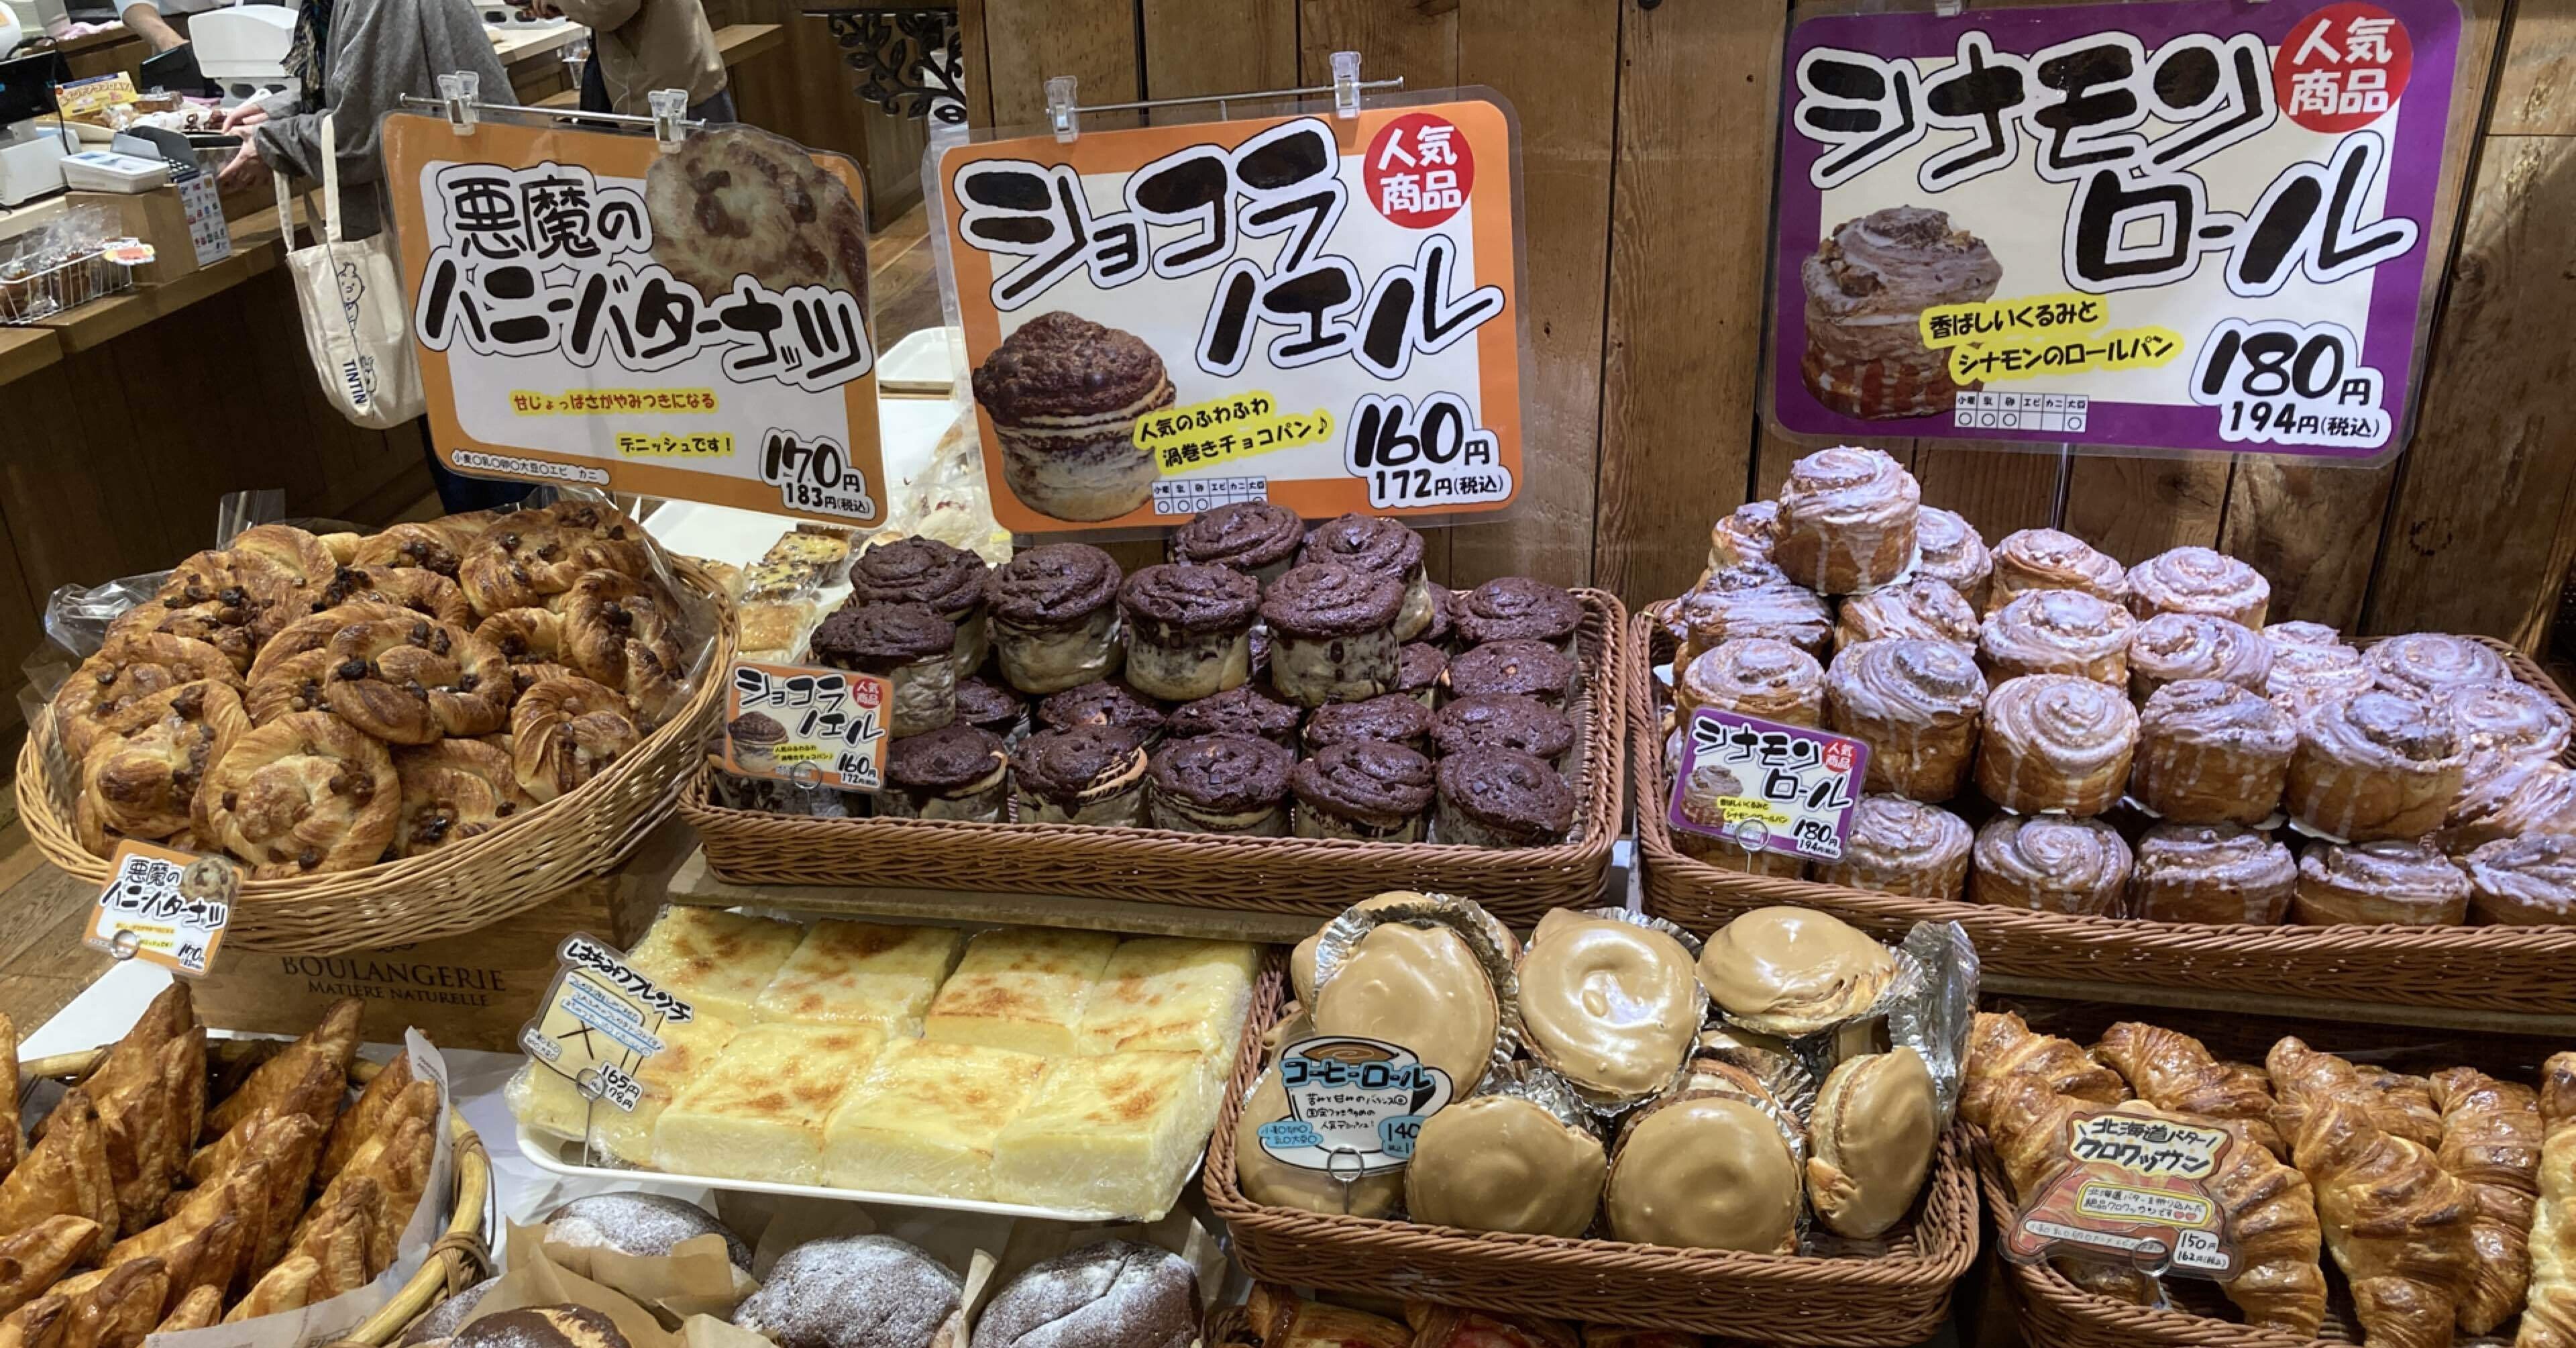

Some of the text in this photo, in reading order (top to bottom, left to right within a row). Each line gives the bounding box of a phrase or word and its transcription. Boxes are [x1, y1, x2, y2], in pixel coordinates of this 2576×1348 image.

[2292, 17, 2393, 65] 人気
[1805, 42, 2263, 177] シナモン
[2288, 68, 2390, 117] 商品
[1378, 125, 1459, 167] 人気
[964, 129, 1336, 301] ショコラ
[1380, 173, 1462, 215] 商品
[2076, 144, 2403, 283] ロール
[448, 175, 641, 260] 悪魔の
[426, 260, 861, 380] ハニーバターナッツ
[1208, 246, 1495, 368] ノエル
[1930, 301, 2099, 340] 香ばしいくるみと
[1958, 335, 2174, 375] シナモンのロールパン
[2202, 329, 2371, 406] 180円
[343, 359, 367, 404] TINTIN
[1140, 397, 1269, 442] 人気のふわふわ
[1354, 402, 1490, 468] 160円
[2231, 401, 2379, 437] 194円(税込)
[766, 435, 860, 492] 170円
[1377, 468, 1503, 499] 172円(税込)
[786, 482, 869, 513] 183円(税込)
[737, 670, 843, 713] ショコラ
[800, 709, 883, 744] ノエル
[1695, 719, 1819, 770] シナモン
[1765, 769, 1850, 808] ロール
[1794, 819, 1837, 846] 180円
[127, 859, 180, 886] 悪魔の
[281, 955, 506, 991] BOULANGERIE
[568, 942, 690, 1020] はちみつフレンチ
[390, 988, 489, 1006] NATURELLE
[603, 1066, 639, 1098] 165円
[1285, 1061, 1432, 1088] コーヒーロール
[606, 1085, 633, 1108] 78円
[2092, 1118, 2207, 1146] 北海道バター
[2074, 1138, 2210, 1172] クロワッサン
